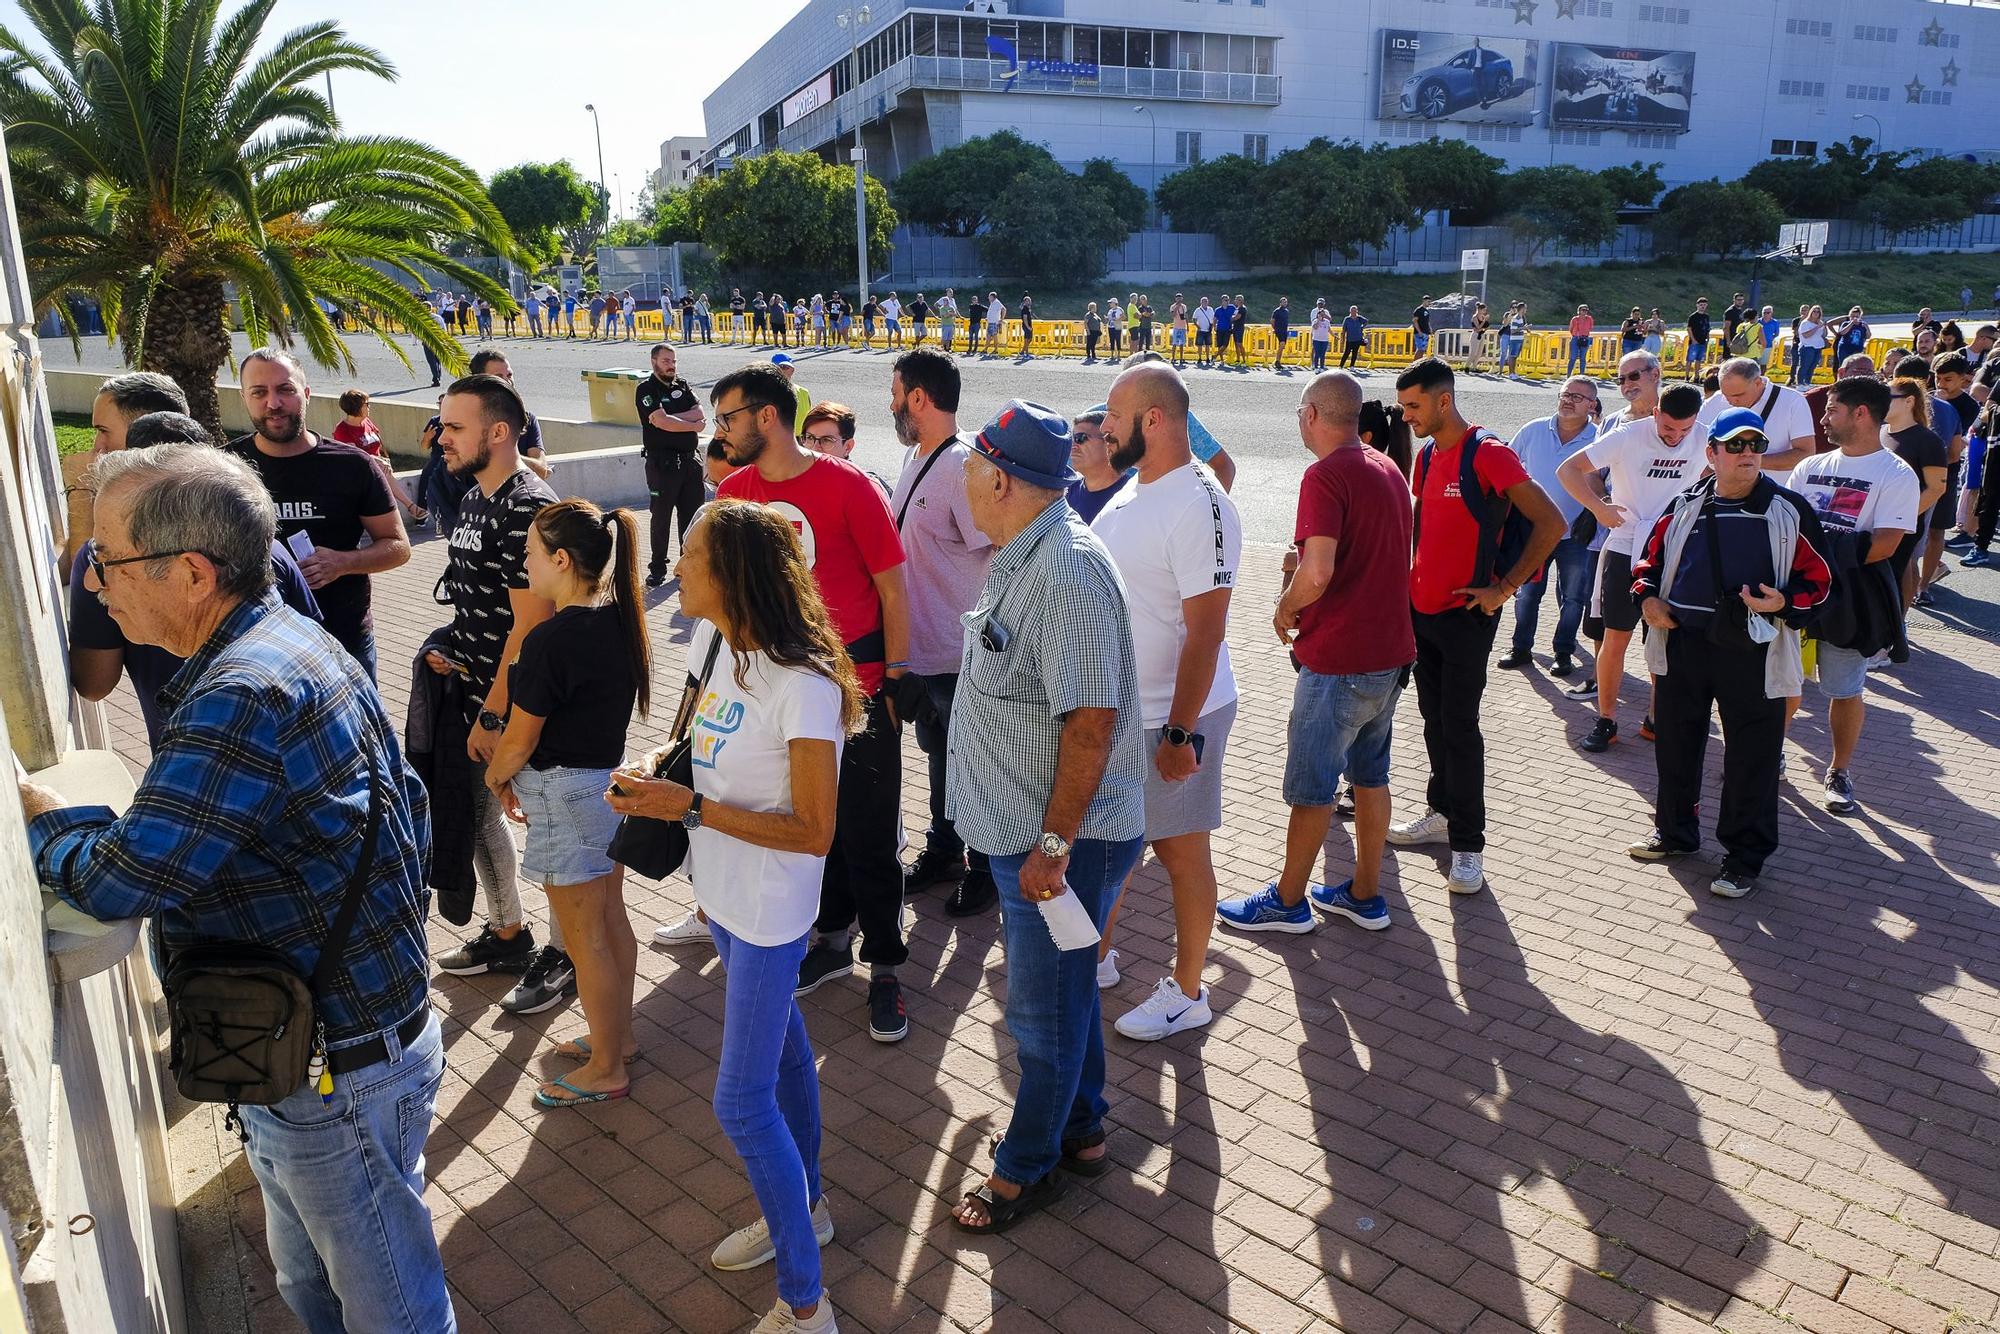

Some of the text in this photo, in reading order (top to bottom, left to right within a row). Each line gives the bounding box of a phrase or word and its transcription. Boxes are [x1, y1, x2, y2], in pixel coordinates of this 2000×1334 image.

[1392, 38, 1420, 50] ID.5
[273, 502, 313, 517] ARIS
[1214, 571, 1232, 586] NIKE
